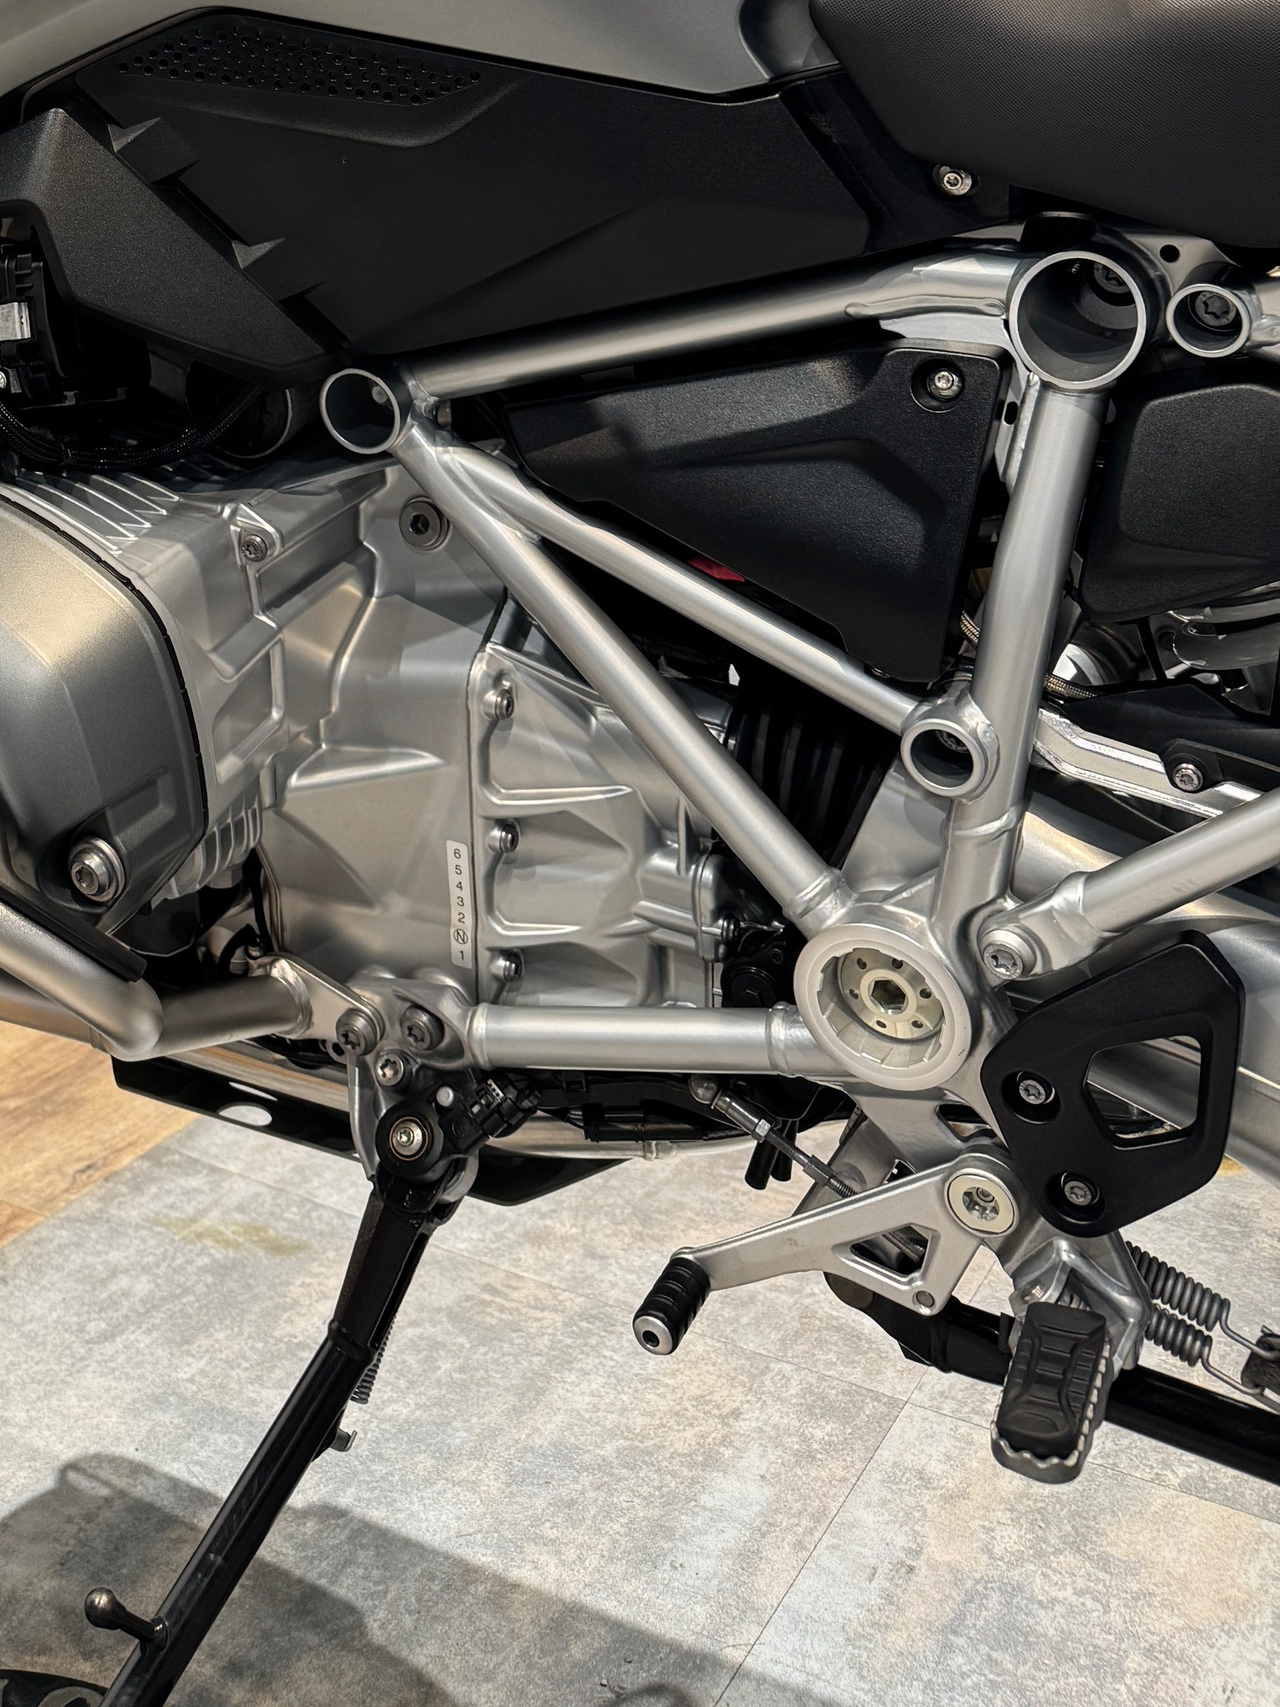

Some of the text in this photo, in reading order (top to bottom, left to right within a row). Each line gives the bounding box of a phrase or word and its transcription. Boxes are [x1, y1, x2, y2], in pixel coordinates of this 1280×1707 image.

[453, 848, 467, 960] 6 5 4 3 2 N 1
